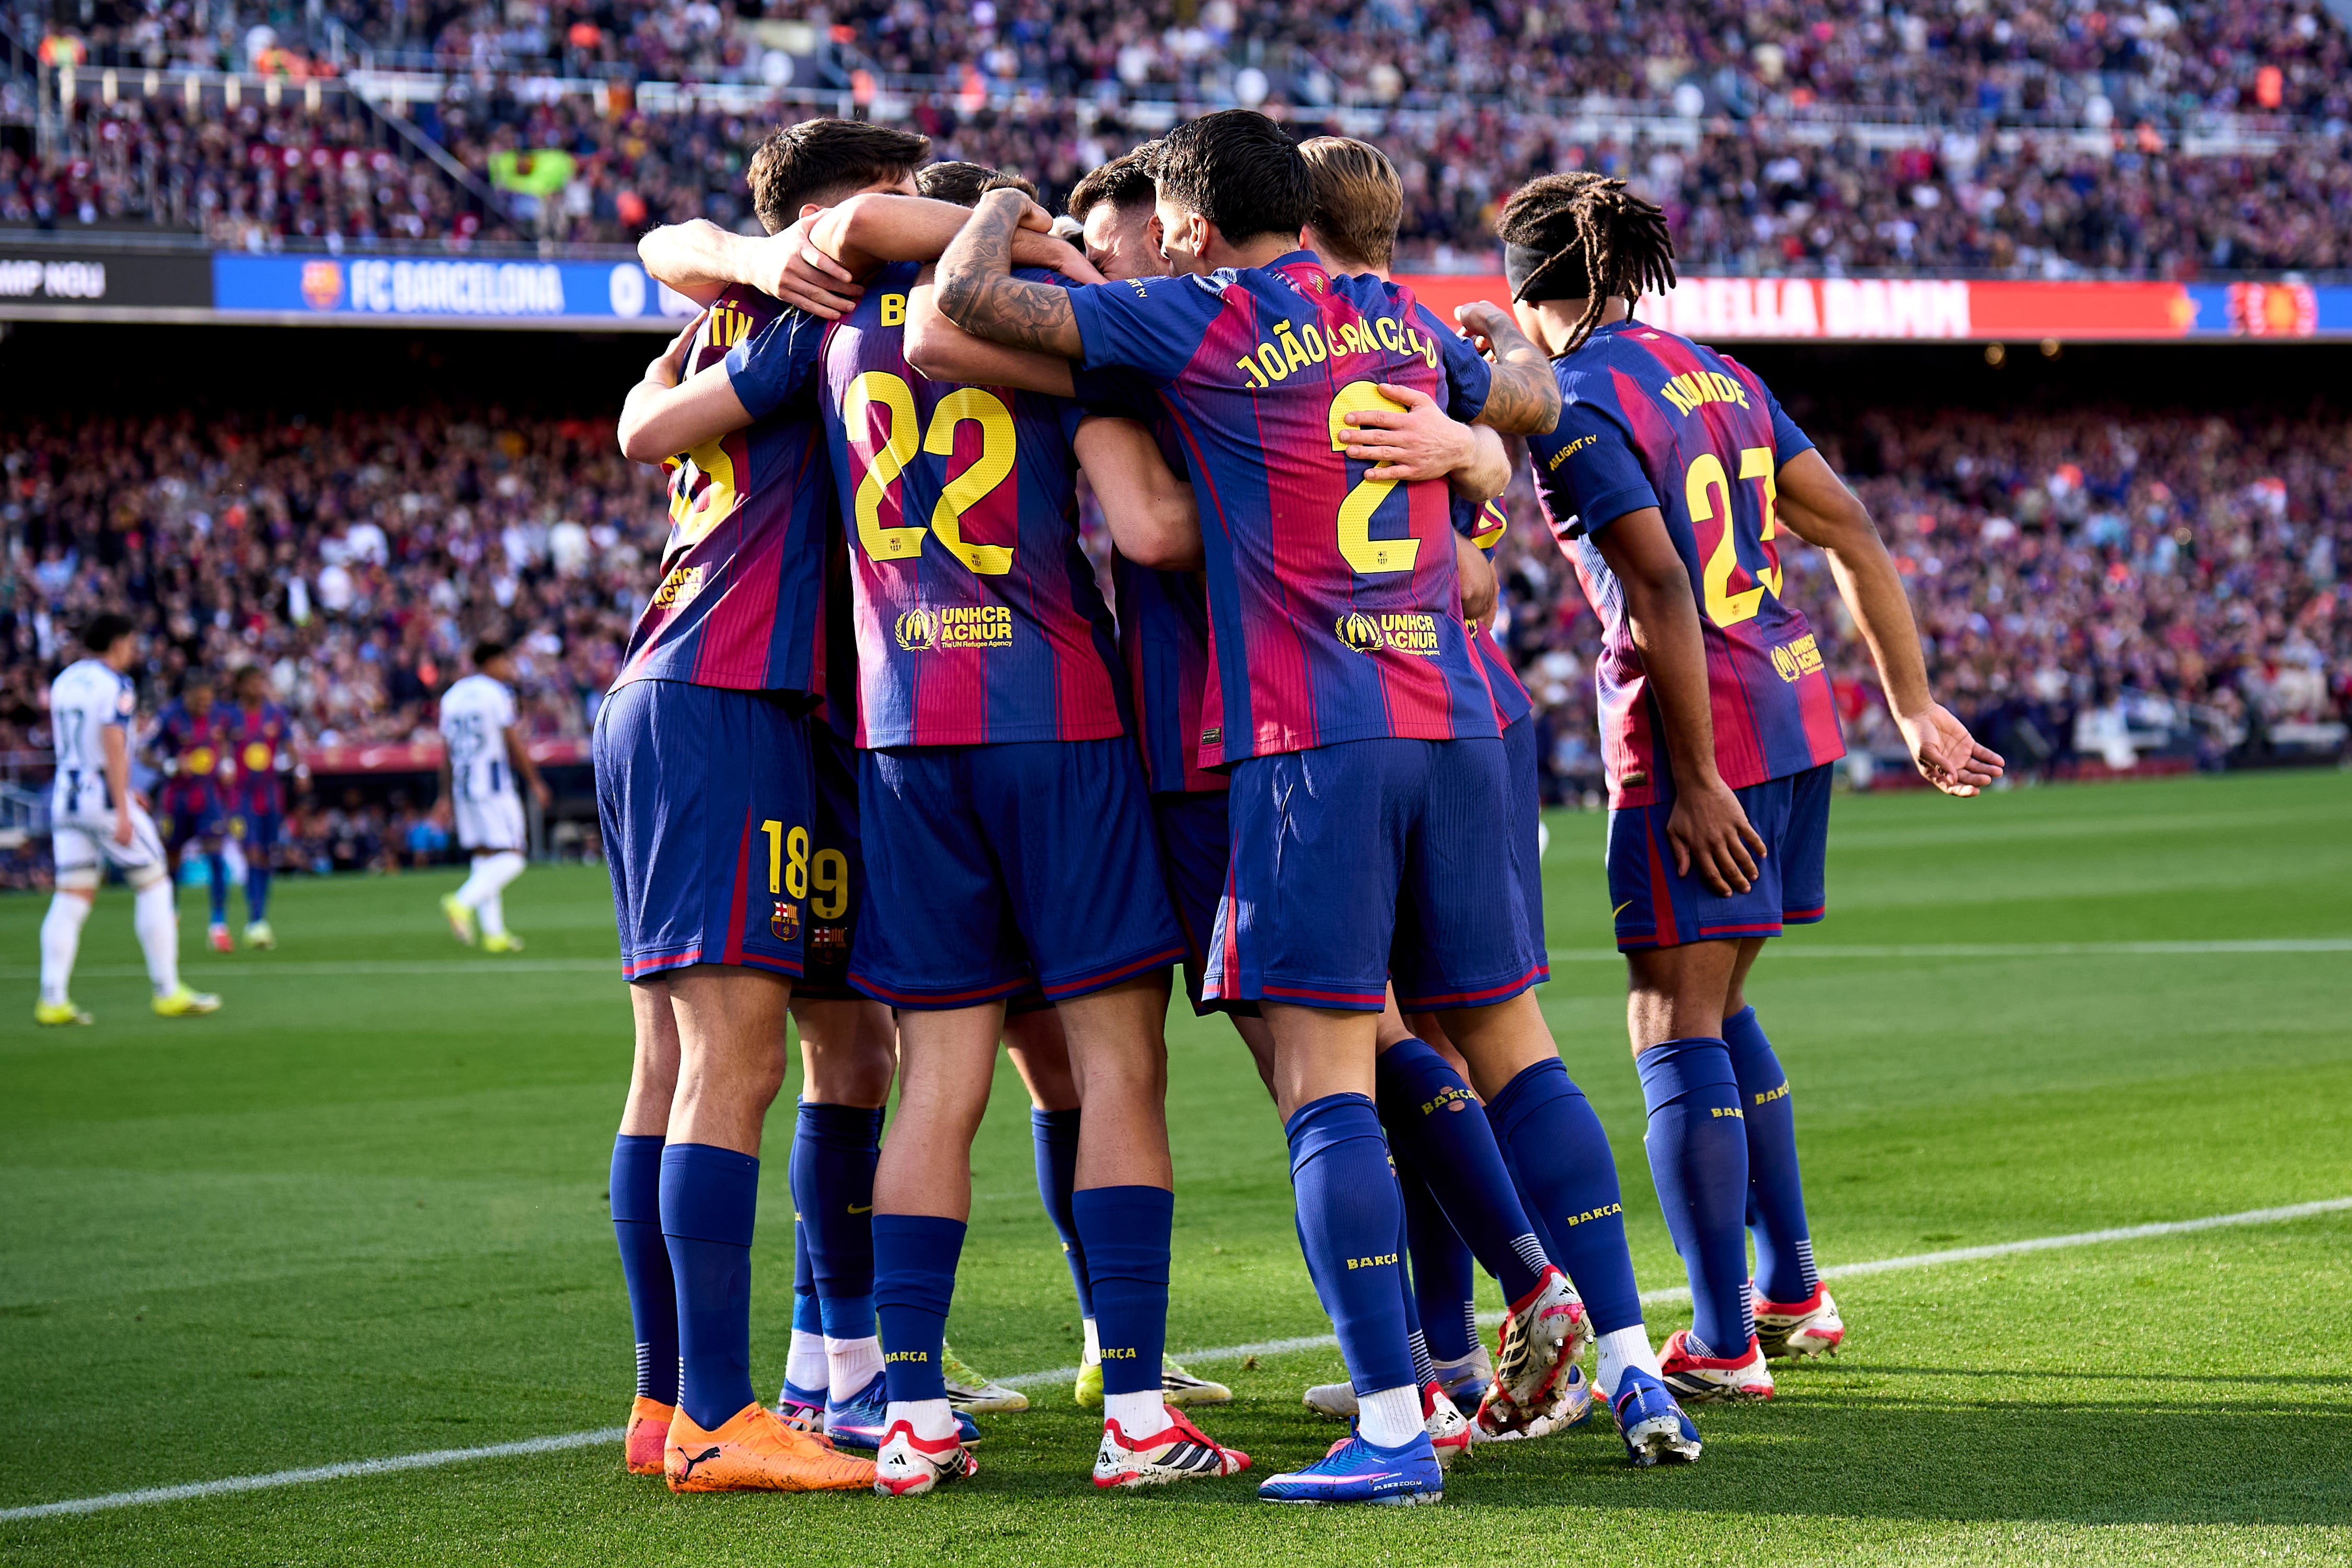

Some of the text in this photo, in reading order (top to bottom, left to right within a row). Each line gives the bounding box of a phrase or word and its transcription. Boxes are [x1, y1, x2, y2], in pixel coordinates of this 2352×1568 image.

[45, 261, 106, 298] NOU
[350, 260, 565, 315] FC BARCELONA
[609, 263, 645, 318] 0
[1823, 279, 1969, 337] DAMM
[1236, 316, 1437, 388] JOÃO CANCELO
[1661, 371, 1750, 417] KOUNDE
[1585, 434, 1597, 445] tv
[844, 371, 1017, 575] 22
[1328, 379, 1422, 574] 2
[941, 606, 1012, 625] UNHCR
[1381, 614, 1436, 631] UNHCR
[940, 623, 1012, 641] ACNUR
[1386, 631, 1438, 649] ACNUR
[760, 819, 809, 900] 18
[810, 848, 848, 919] 9
[1422, 1089, 1477, 1115] BARÇA
[1567, 1203, 1622, 1226] BARÇA
[1347, 1253, 1398, 1270] BARÇA
[885, 1351, 928, 1364] BARÇA
[1099, 1347, 1136, 1360] ARÇA
